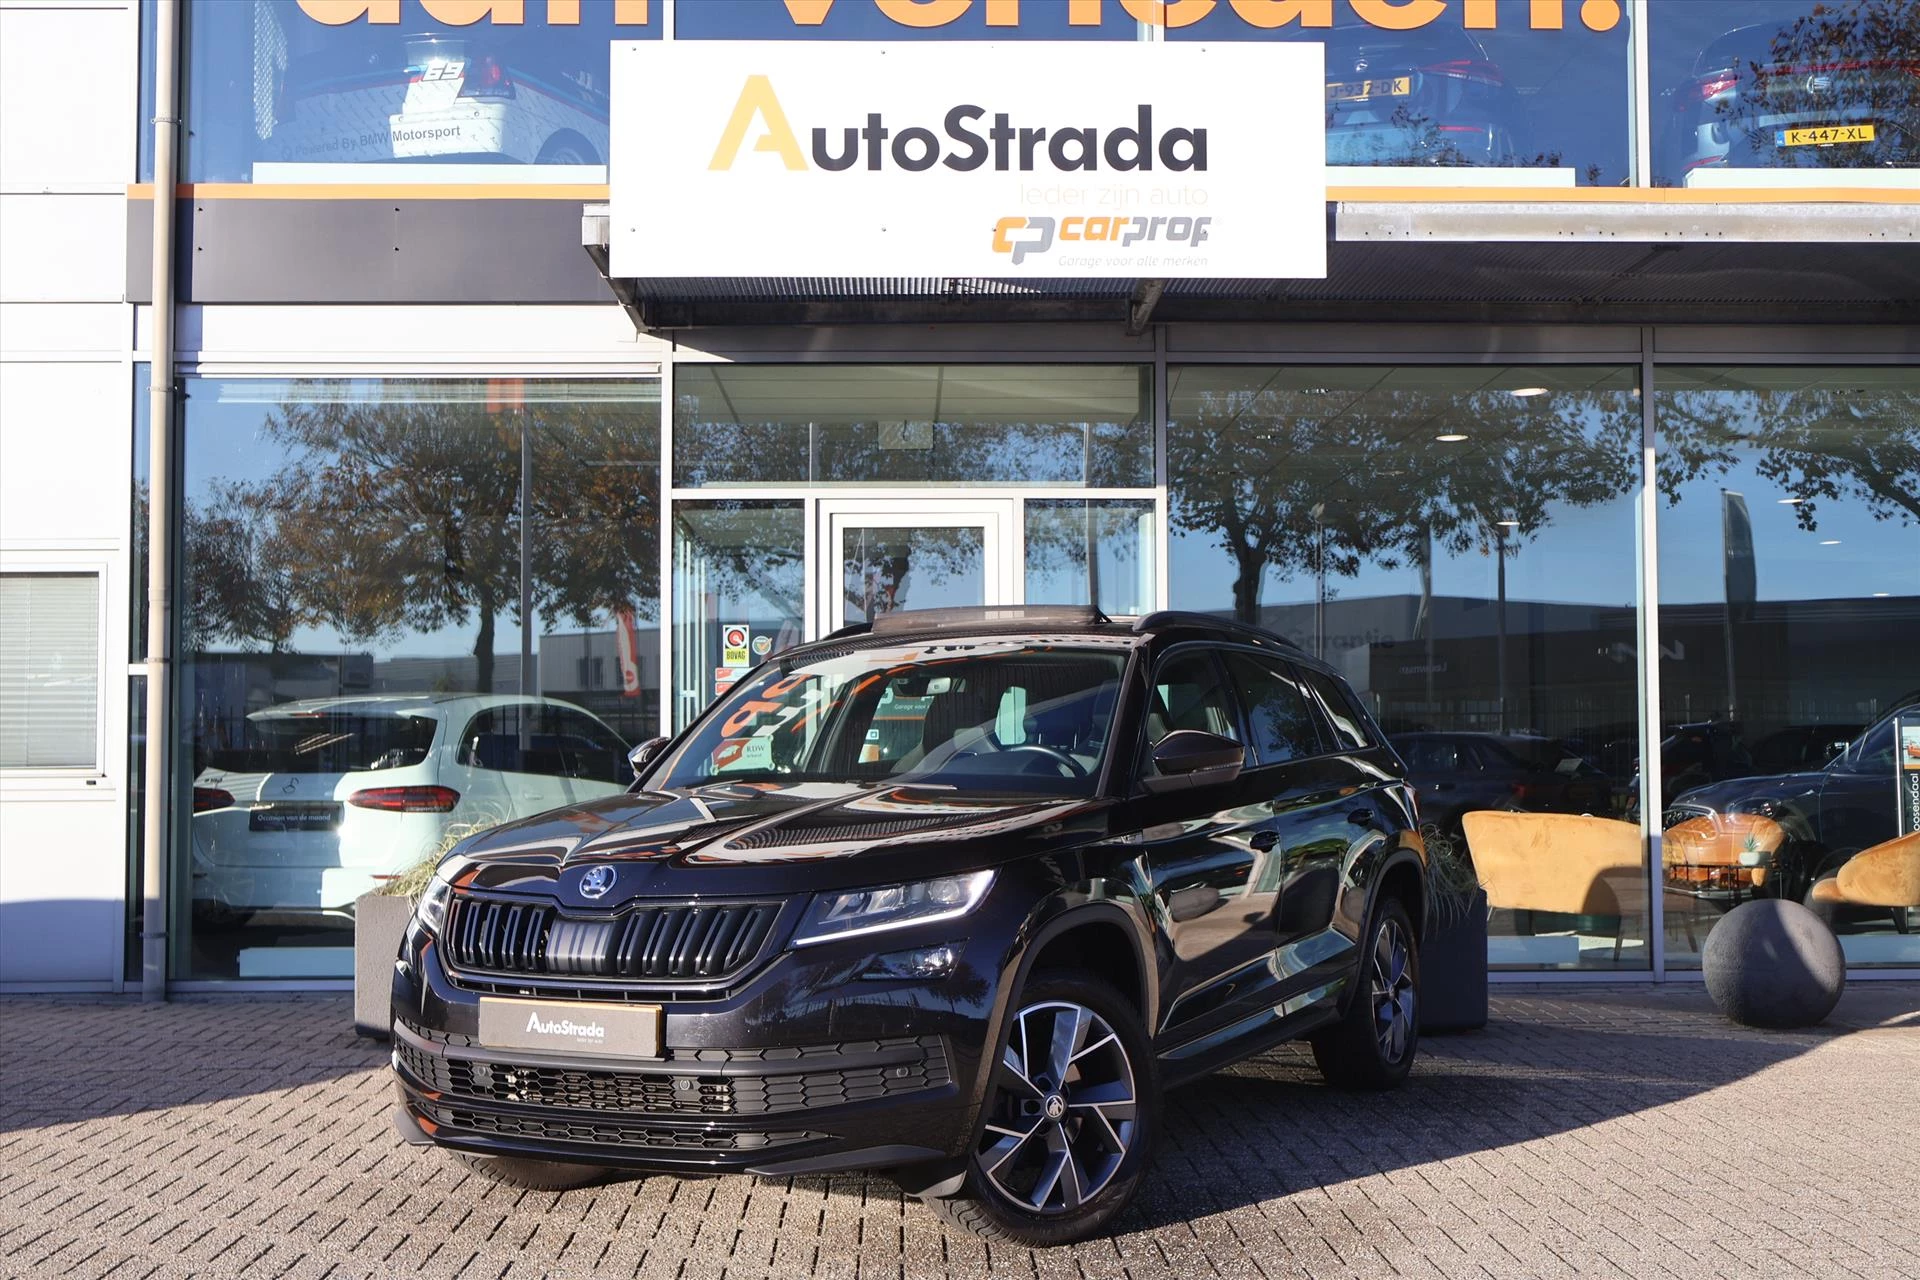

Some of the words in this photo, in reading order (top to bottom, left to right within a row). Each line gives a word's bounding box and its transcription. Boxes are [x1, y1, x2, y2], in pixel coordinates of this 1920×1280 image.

[423, 62, 465, 81] 69
[707, 74, 1208, 173] AutoStrada
[342, 136, 356, 152] By
[360, 132, 389, 147] BMW
[392, 125, 461, 142] Motorsport
[1791, 128, 1867, 143] K-447-XL
[1099, 184, 1140, 210] zijn
[1150, 186, 1209, 205] auto
[1058, 255, 1102, 268] Garage
[1106, 258, 1134, 267] voor
[1137, 256, 1160, 267] alle
[1163, 256, 1208, 267] merken
[726, 650, 746, 660] BOVAG
[299, 813, 307, 821] de
[525, 1011, 605, 1038] AutoStrada
